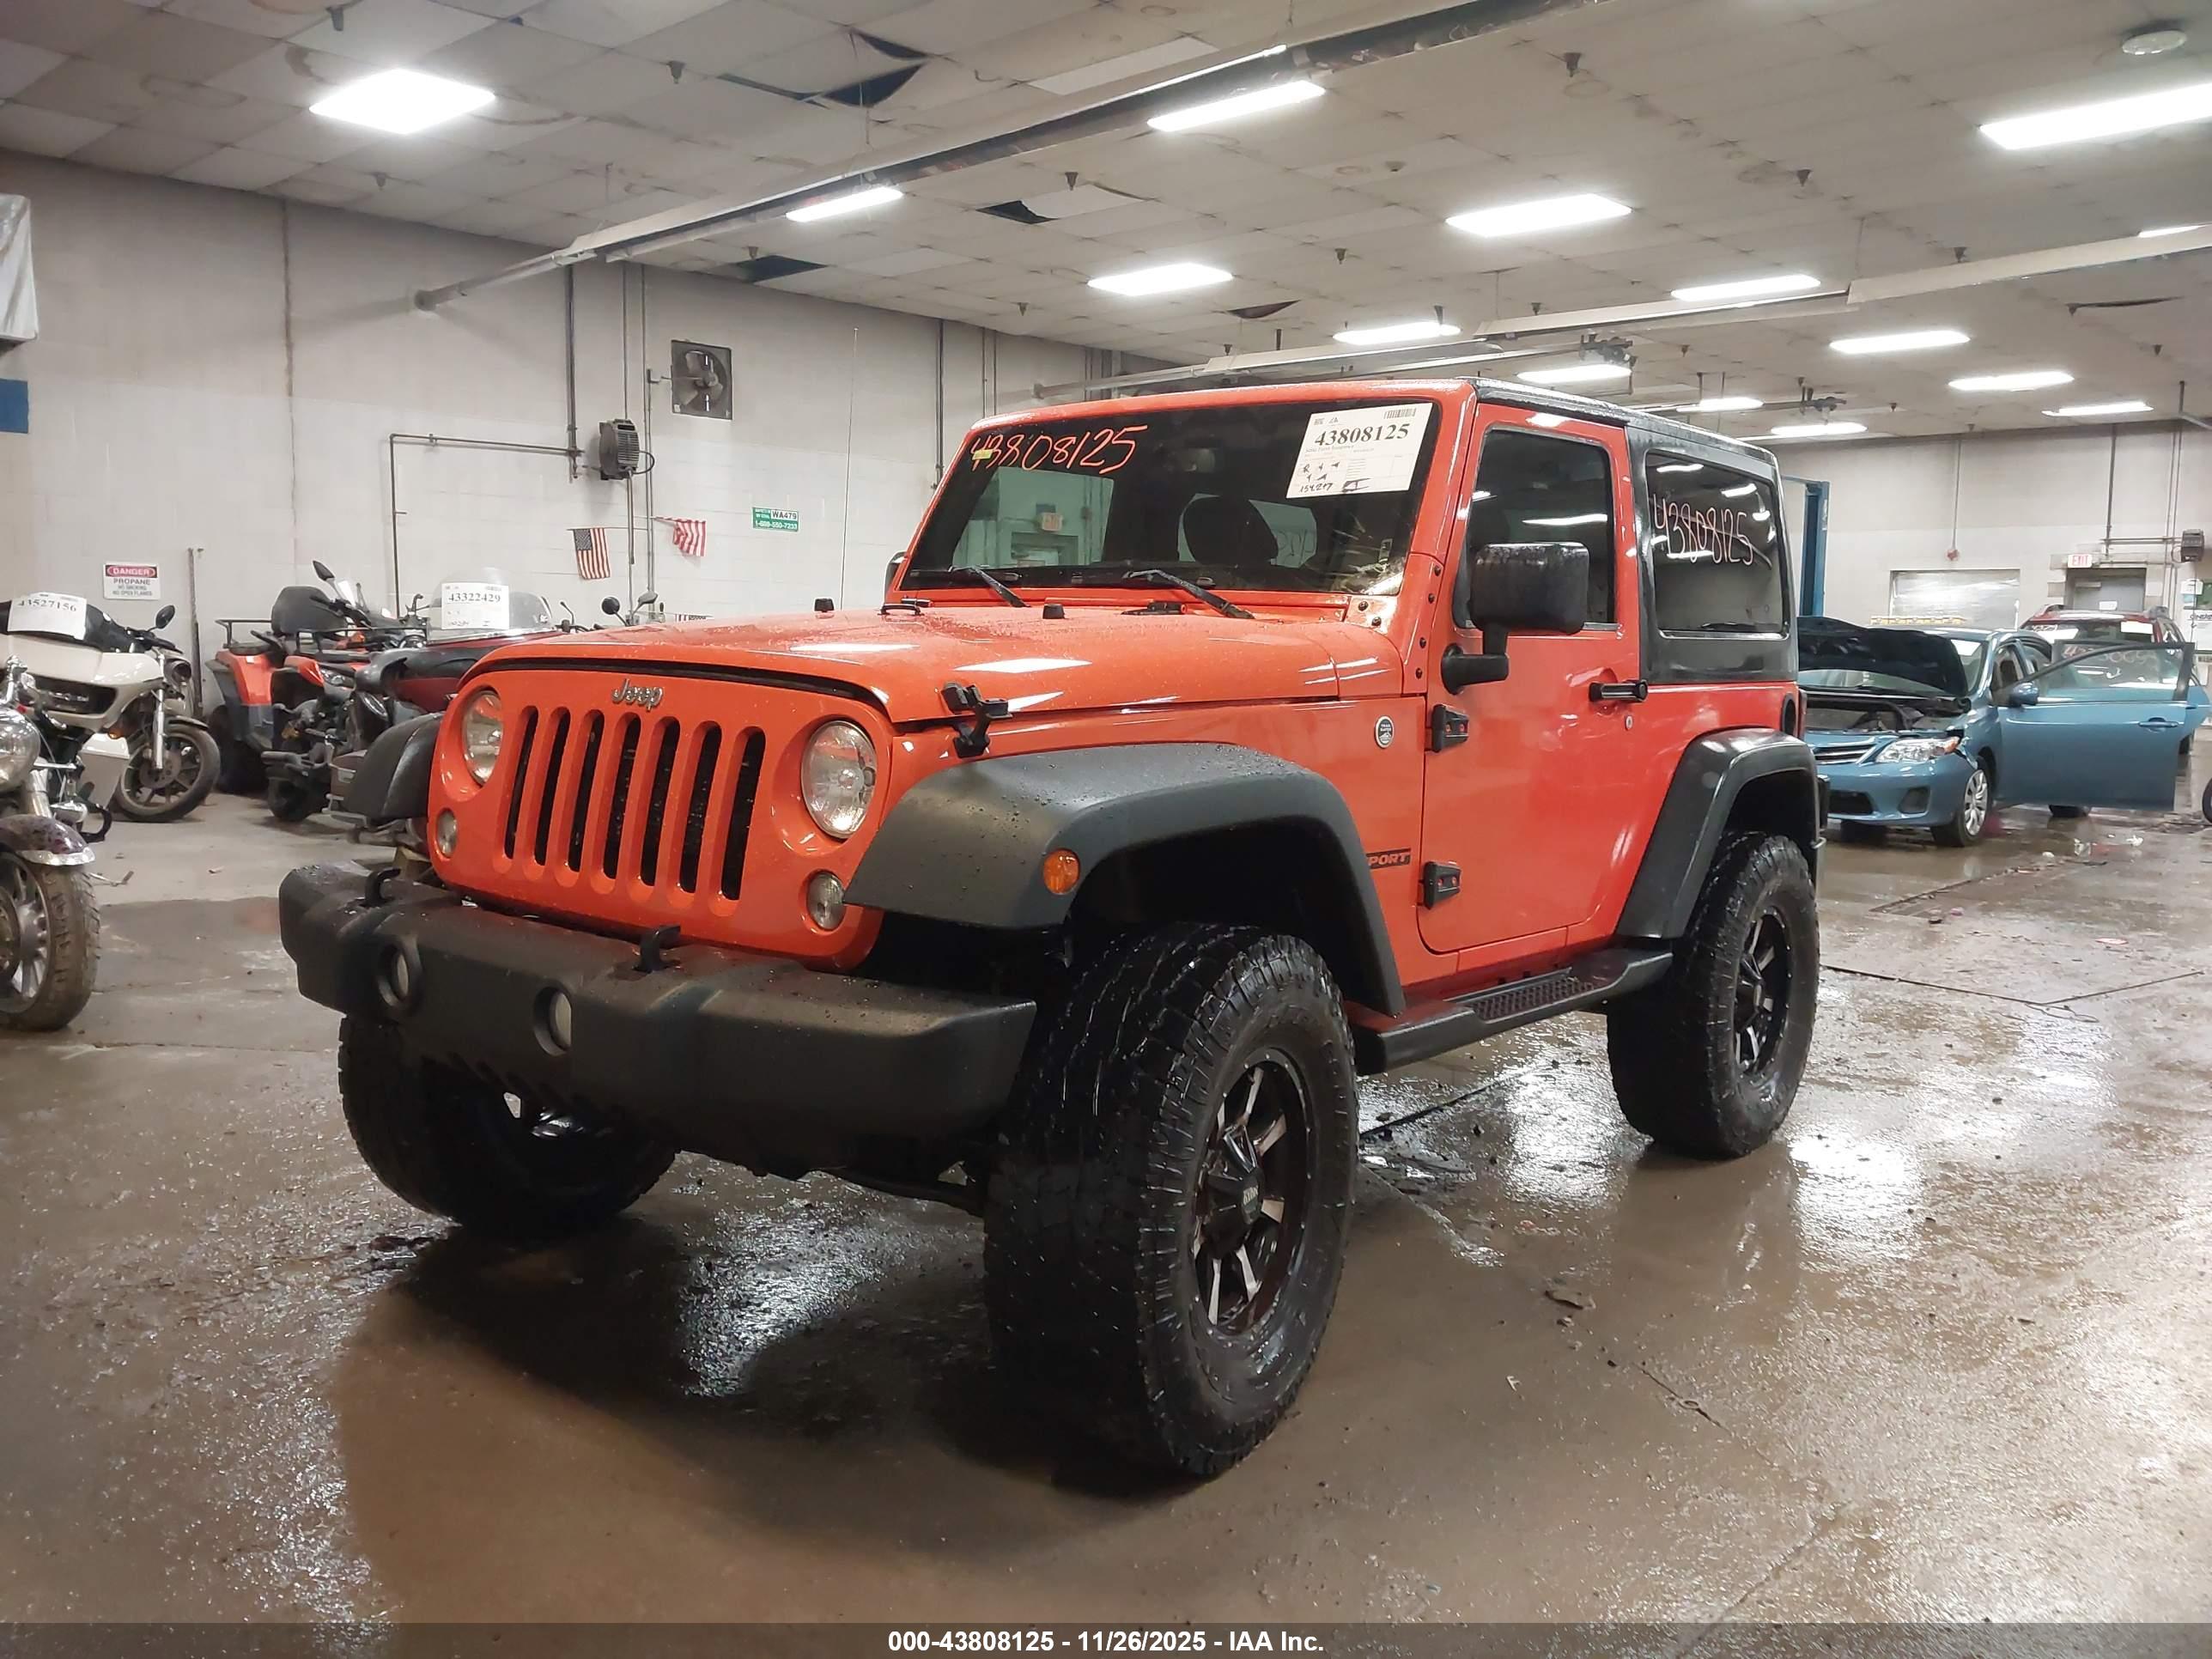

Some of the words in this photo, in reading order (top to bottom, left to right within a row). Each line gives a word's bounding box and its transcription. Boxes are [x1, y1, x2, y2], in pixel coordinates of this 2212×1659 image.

[1315, 422, 1411, 447] 43808125
[970, 425, 1149, 474] 43808125
[772, 510, 797, 520] WA479
[1653, 493, 1754, 566] 43808125
[112, 567, 150, 576] DANGER
[113, 577, 151, 586] PROPANE
[448, 592, 501, 603] 43322429
[611, 678, 663, 711] Jeep
[1368, 852, 1410, 866] PORT
